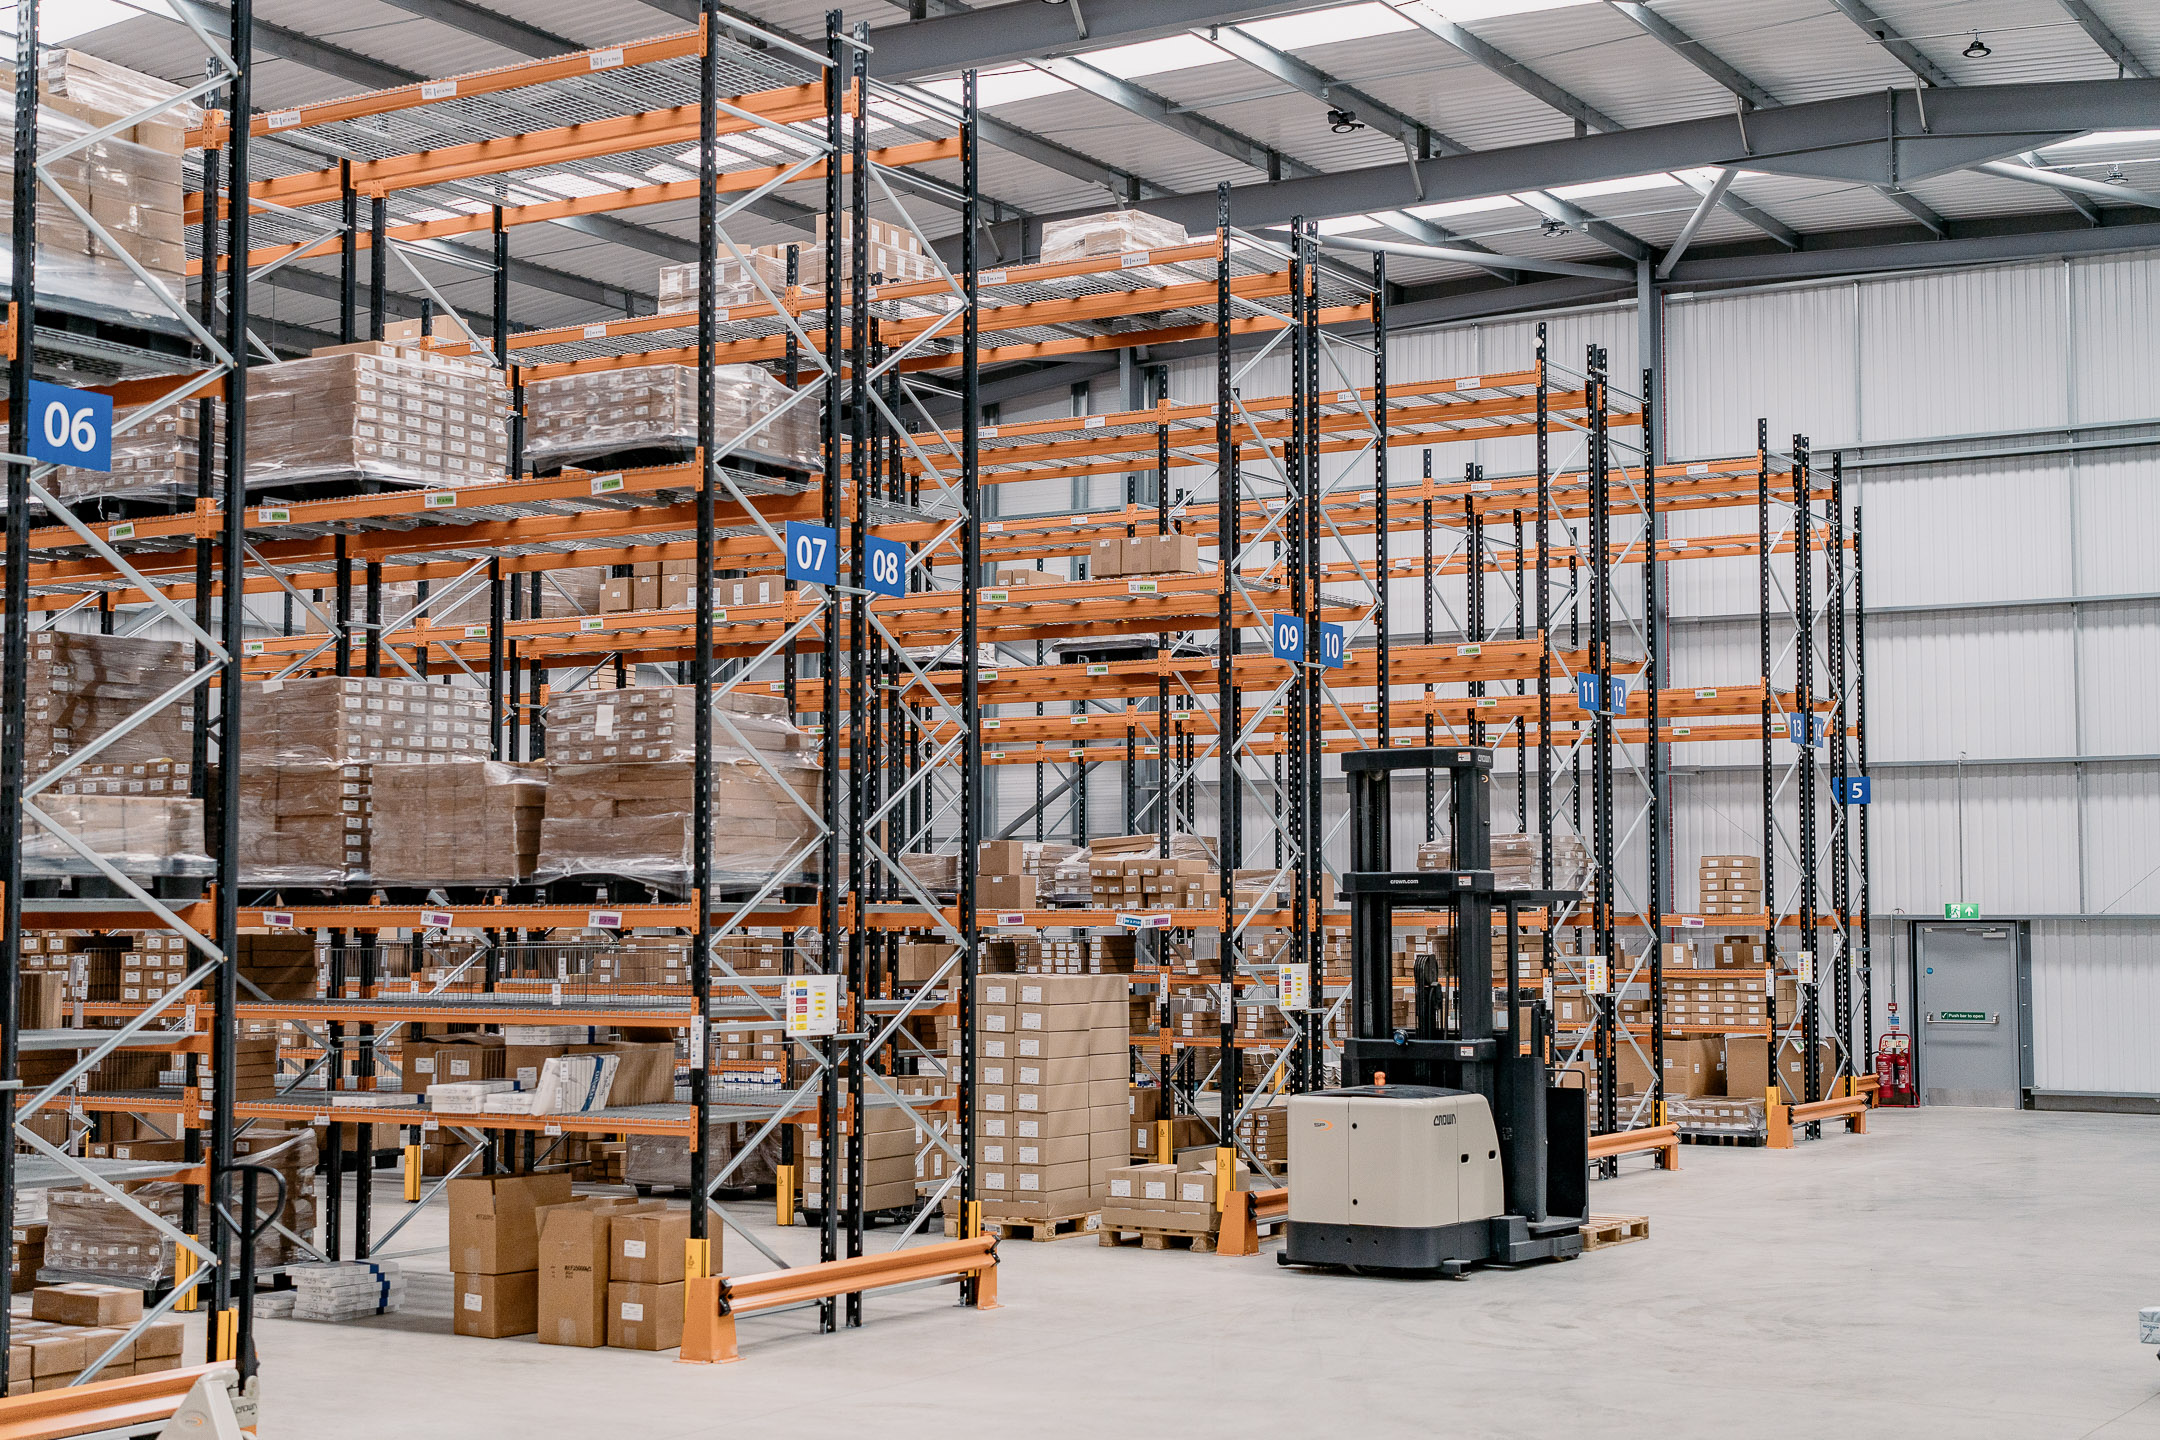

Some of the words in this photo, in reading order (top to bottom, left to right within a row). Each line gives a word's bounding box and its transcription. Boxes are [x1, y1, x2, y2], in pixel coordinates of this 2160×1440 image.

[44, 402, 96, 451] 06
[796, 535, 827, 571] 07
[873, 549, 898, 585] 08
[1279, 624, 1299, 651] 09
[1325, 632, 1339, 659] 10
[1583, 681, 1594, 703] 11
[1614, 686, 1624, 707] 12
[1793, 719, 1802, 738] 13
[1814, 723, 1822, 741] 14
[1851, 782, 1864, 799] 5
